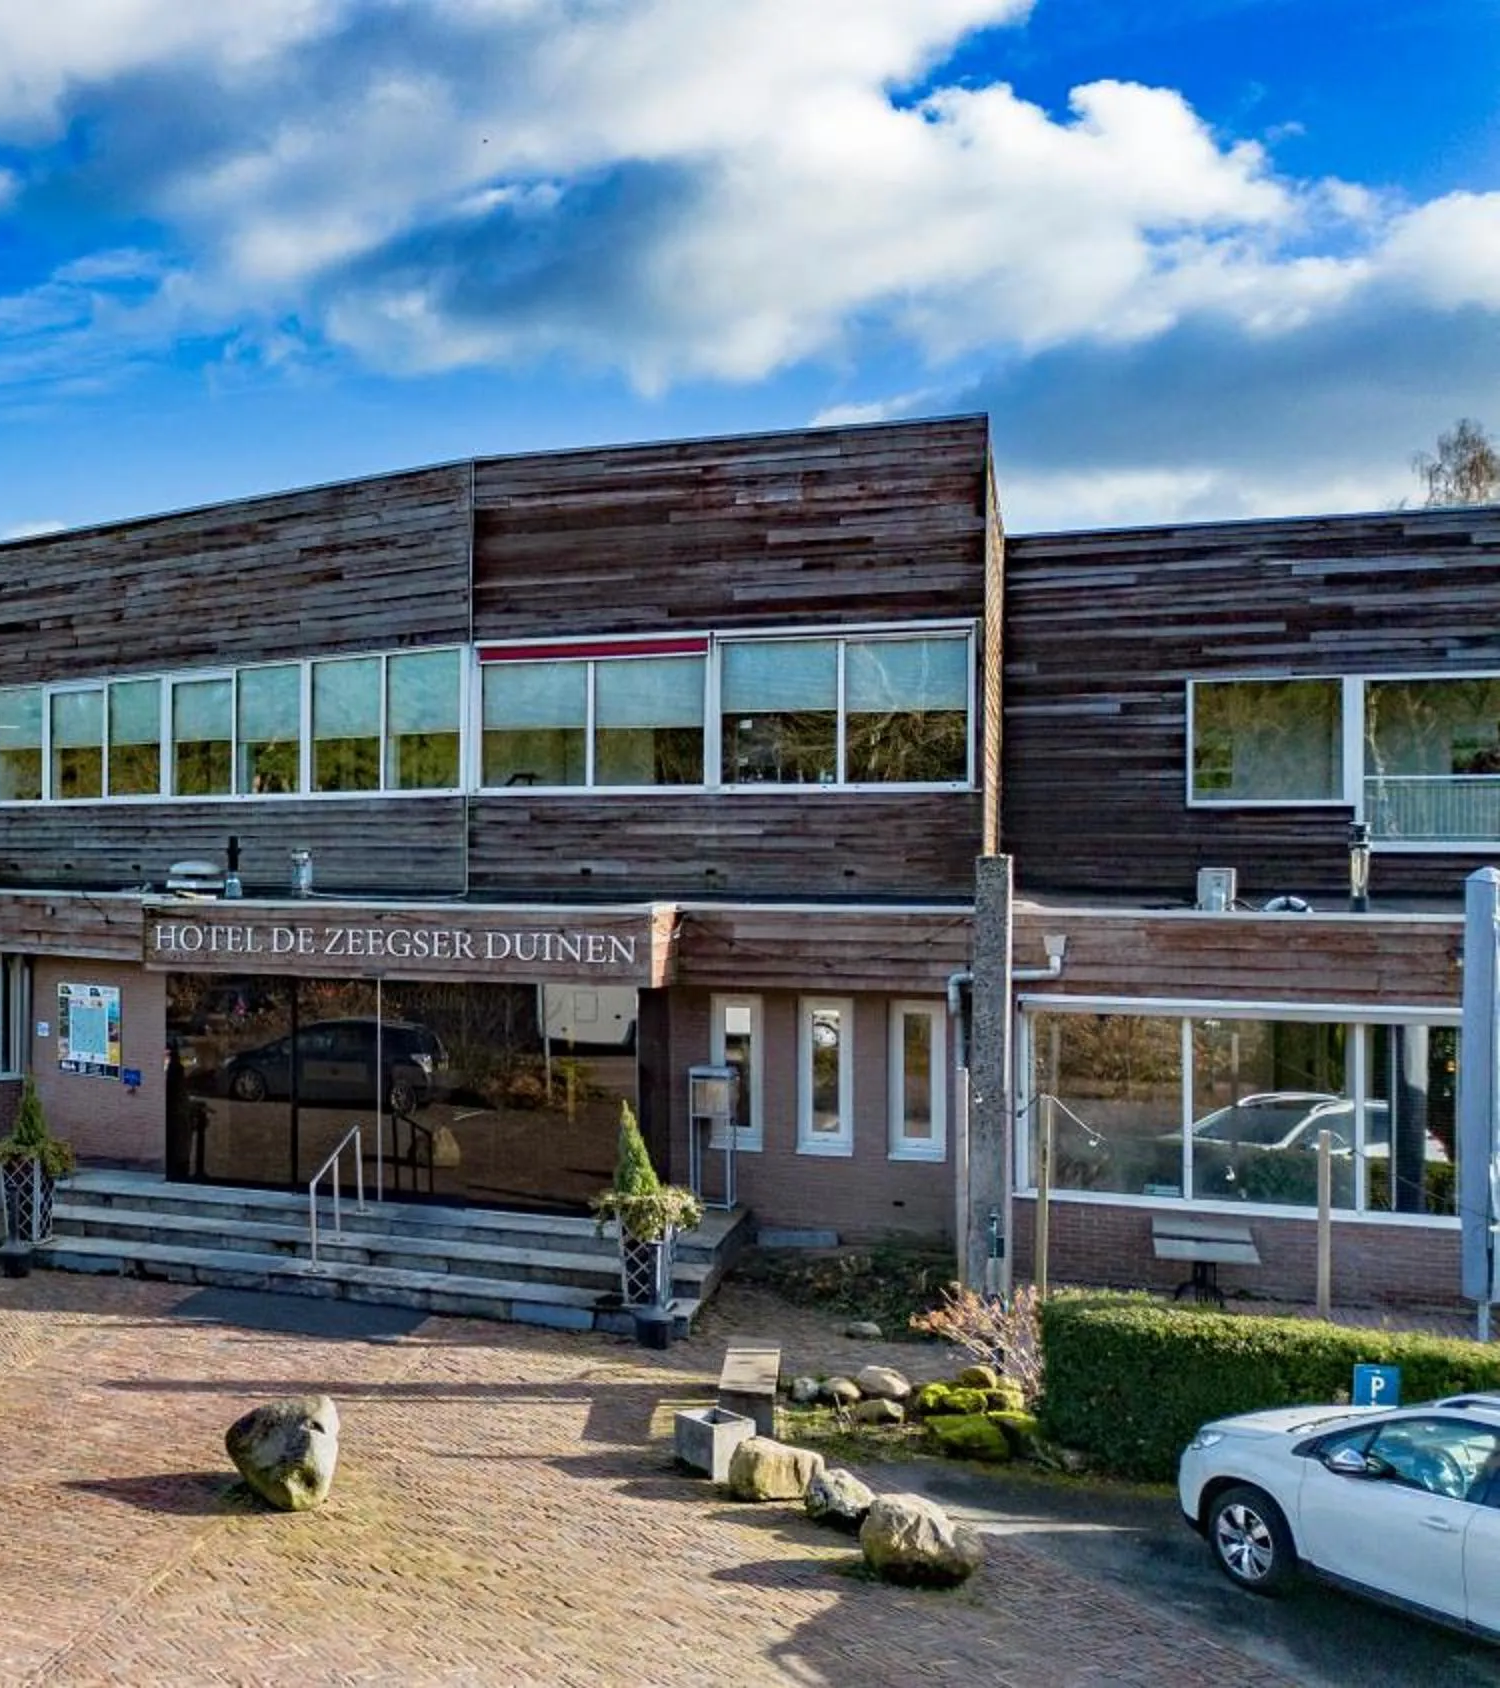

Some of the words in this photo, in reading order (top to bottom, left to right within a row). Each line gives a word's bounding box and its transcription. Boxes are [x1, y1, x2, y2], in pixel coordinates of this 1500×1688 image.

[155, 925, 263, 952] HOTEL
[271, 926, 315, 953] DE
[324, 927, 477, 960] ZEEGSER
[484, 932, 638, 964] DUINEN
[1371, 1376, 1385, 1399] P
